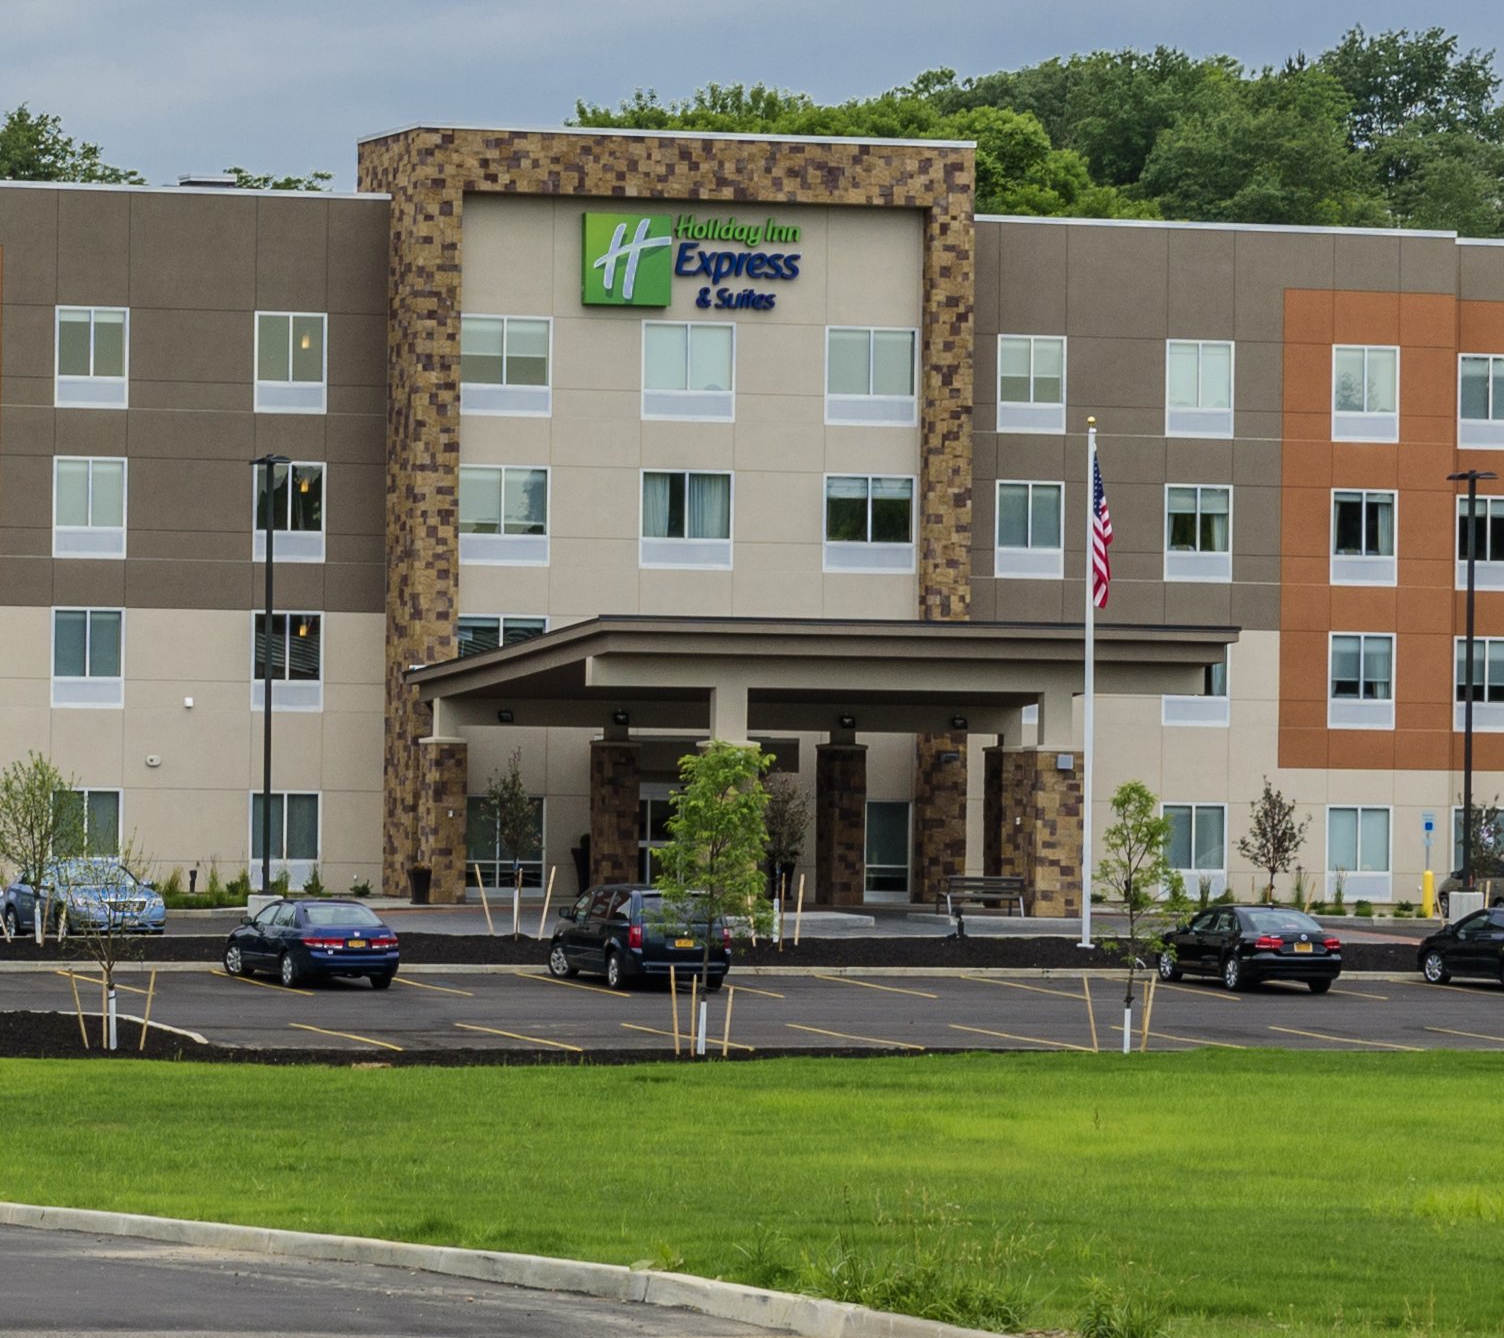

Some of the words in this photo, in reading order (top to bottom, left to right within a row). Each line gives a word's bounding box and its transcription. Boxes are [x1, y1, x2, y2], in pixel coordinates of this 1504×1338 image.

[675, 215, 763, 247] Holiday
[765, 217, 801, 243] Inn
[675, 242, 800, 285] Express
[696, 287, 712, 309] &
[714, 288, 776, 310] Suites
